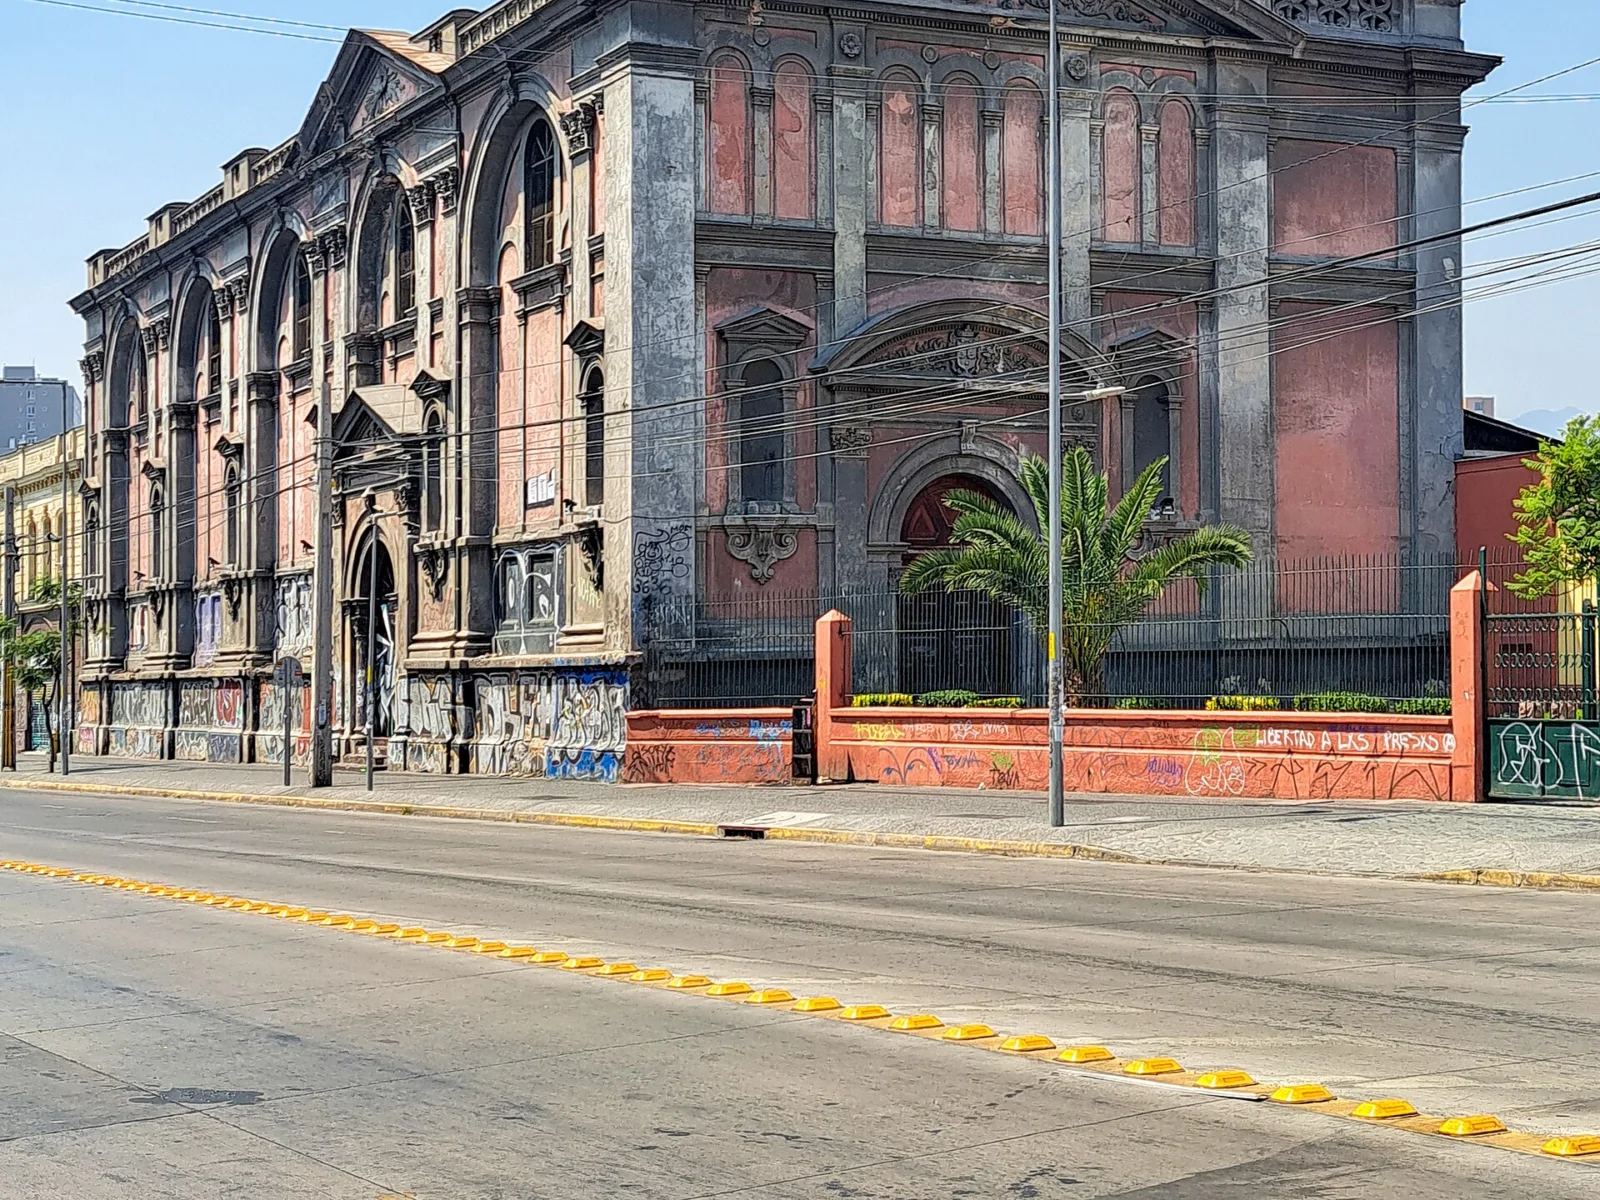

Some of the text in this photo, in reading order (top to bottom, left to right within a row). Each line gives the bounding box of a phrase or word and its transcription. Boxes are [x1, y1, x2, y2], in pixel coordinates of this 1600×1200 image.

[1255, 728, 1315, 747] LIBERTAD
[1321, 730, 1332, 750] A
[1337, 732, 1370, 751] LXS
[1383, 730, 1440, 751] PRESXS
